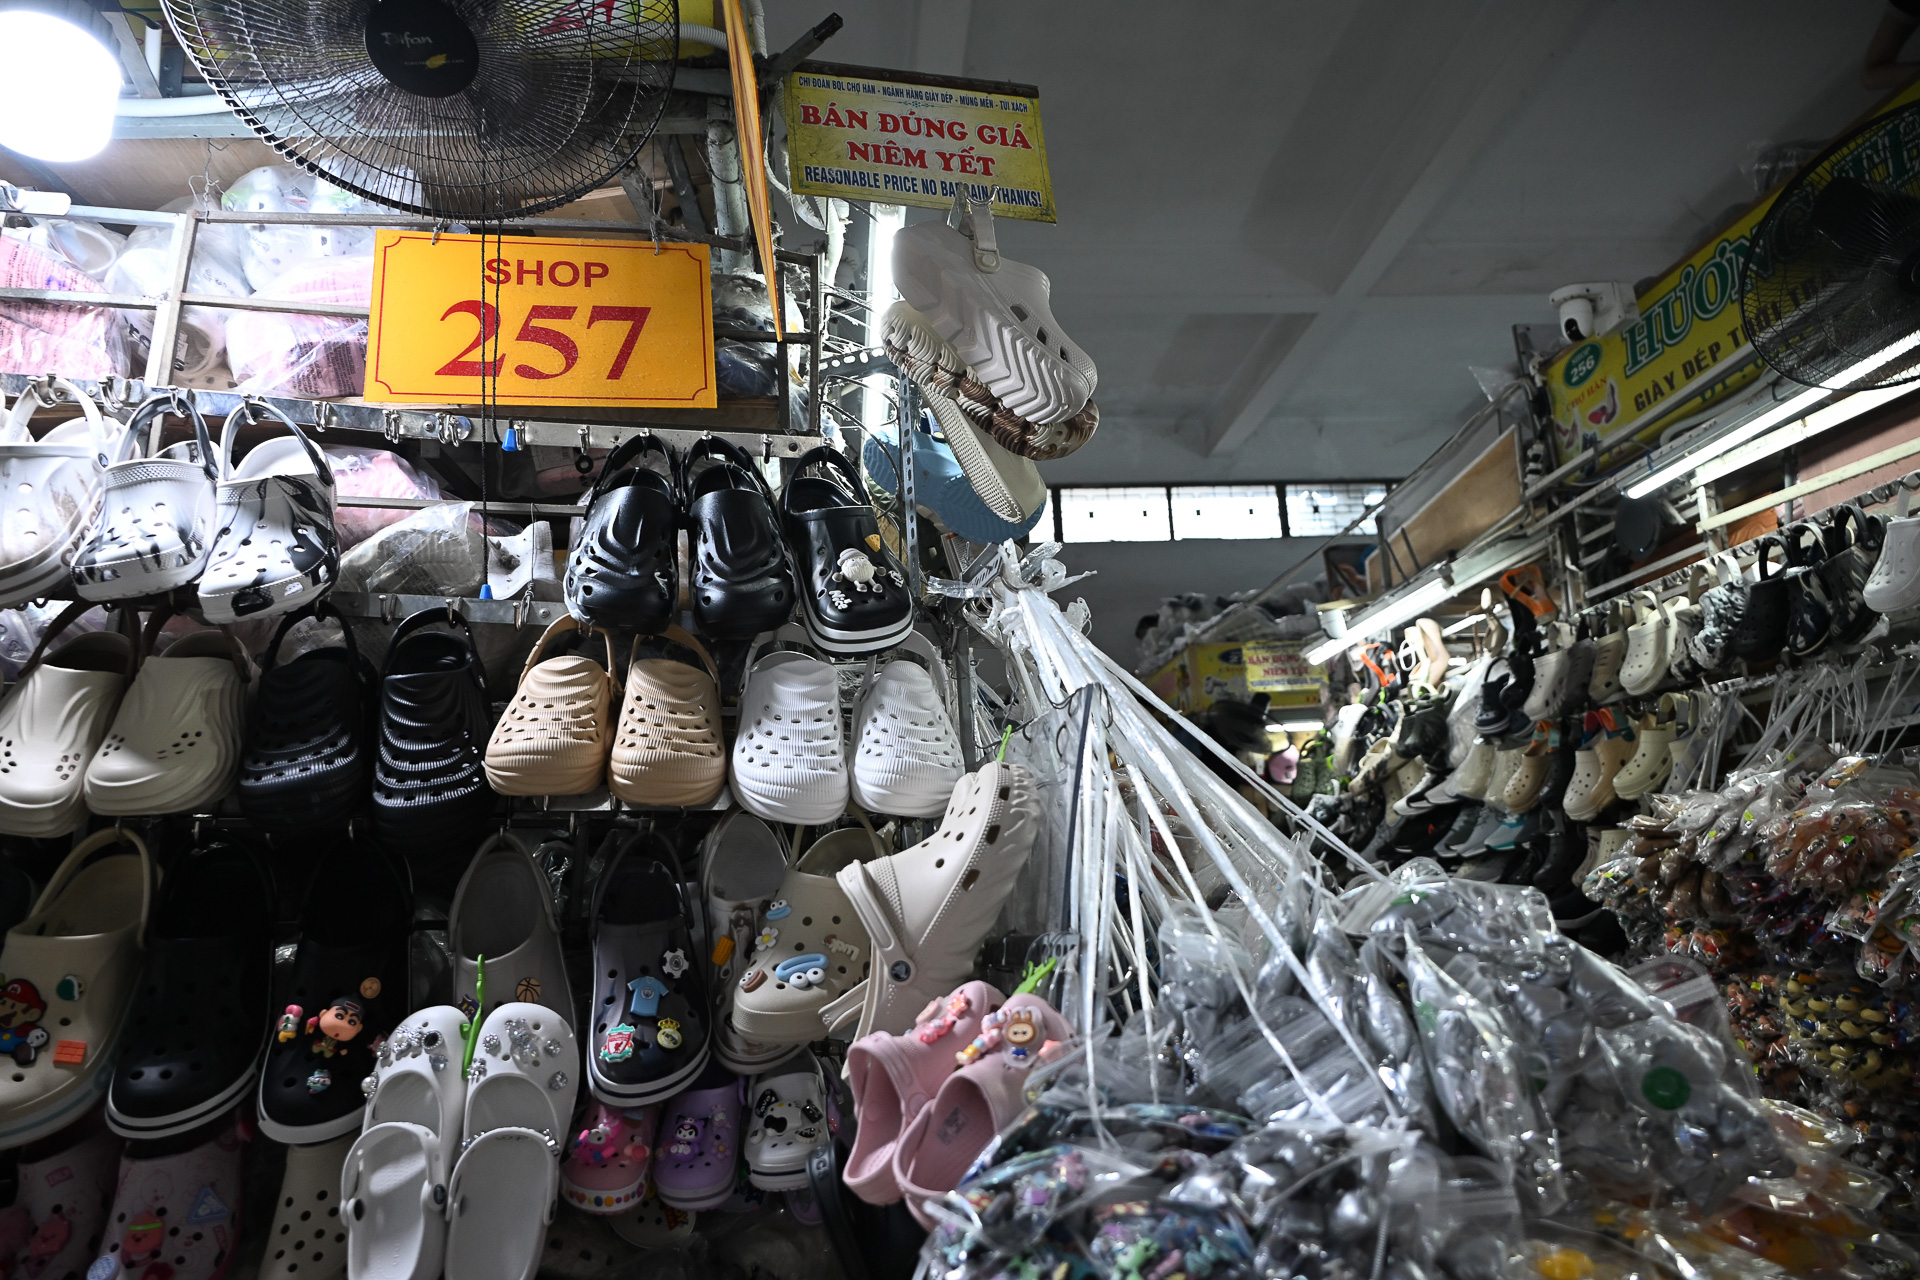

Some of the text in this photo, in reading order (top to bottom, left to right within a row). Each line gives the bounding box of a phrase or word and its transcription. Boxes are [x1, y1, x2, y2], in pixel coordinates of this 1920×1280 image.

[798, 76, 811, 86] CHI
[812, 77, 831, 90] ĐOÀN
[832, 80, 846, 92] BQL
[846, 81, 861, 95] CHỢ
[862, 82, 876, 94] HÀN
[882, 85, 905, 97] NGÀNH
[905, 87, 924, 100] HÀNG
[924, 89, 939, 102] GIÀY
[1011, 100, 1028, 113] XÁCH
[800, 101, 1033, 149] BÁN ĐÚNG GIÁ
[846, 140, 996, 177] NIÊM YẾT
[804, 165, 881, 189] REASONABLE
[883, 173, 919, 194] PRICE
[921, 178, 938, 196] NO
[997, 187, 1043, 207] THANKS!
[484, 257, 610, 288] SHOP
[434, 299, 652, 381] 257
[1570, 354, 1596, 384] 256
[1633, 370, 1676, 412] GIÀY
[1681, 339, 1722, 381] DÉP
